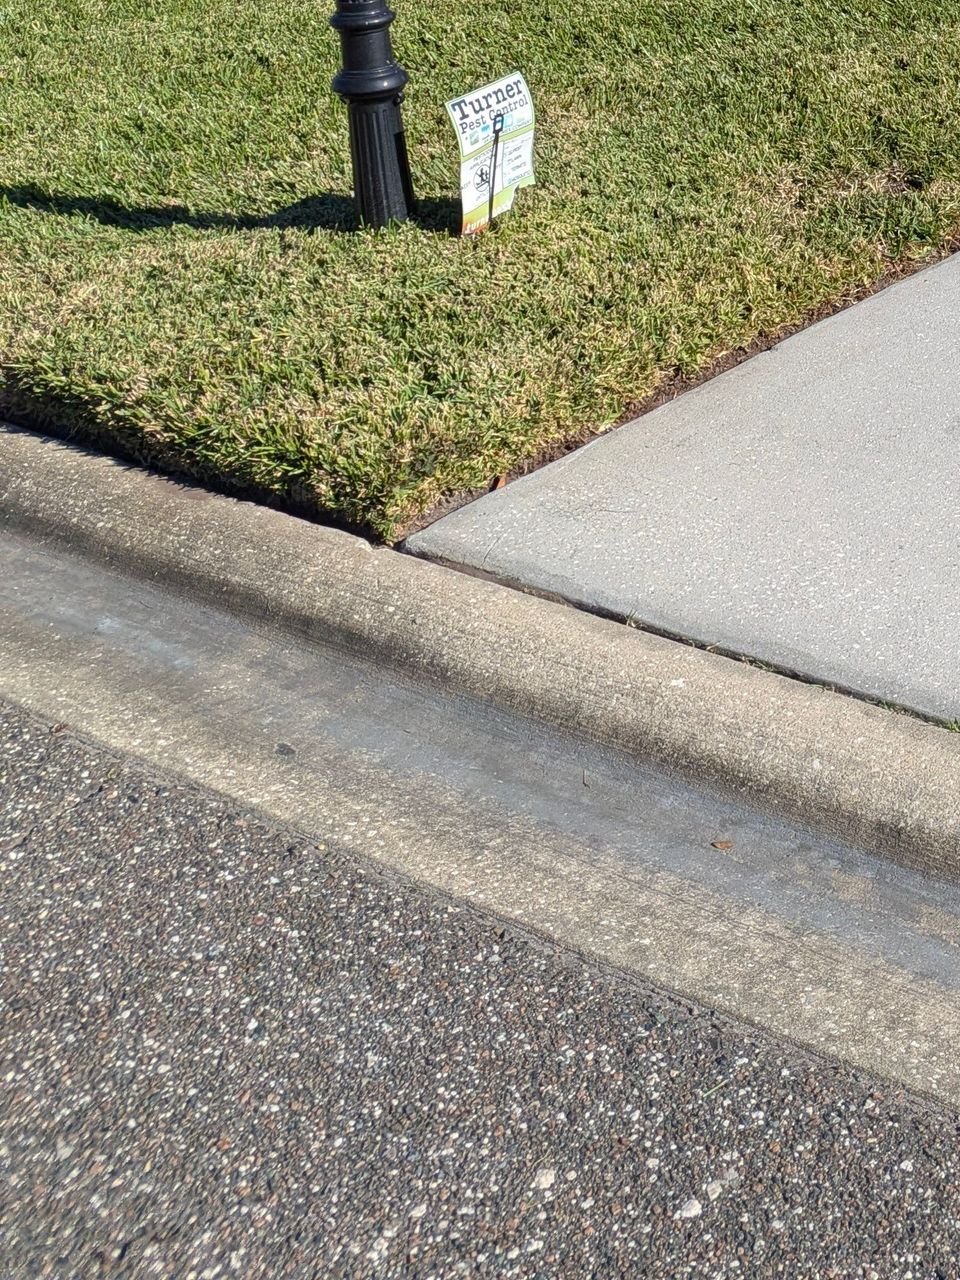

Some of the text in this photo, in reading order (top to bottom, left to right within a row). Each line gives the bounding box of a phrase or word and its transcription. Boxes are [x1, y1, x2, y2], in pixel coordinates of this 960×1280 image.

[450, 79, 522, 121] Turner
[459, 114, 487, 134] Pest
[489, 94, 528, 121] Control
